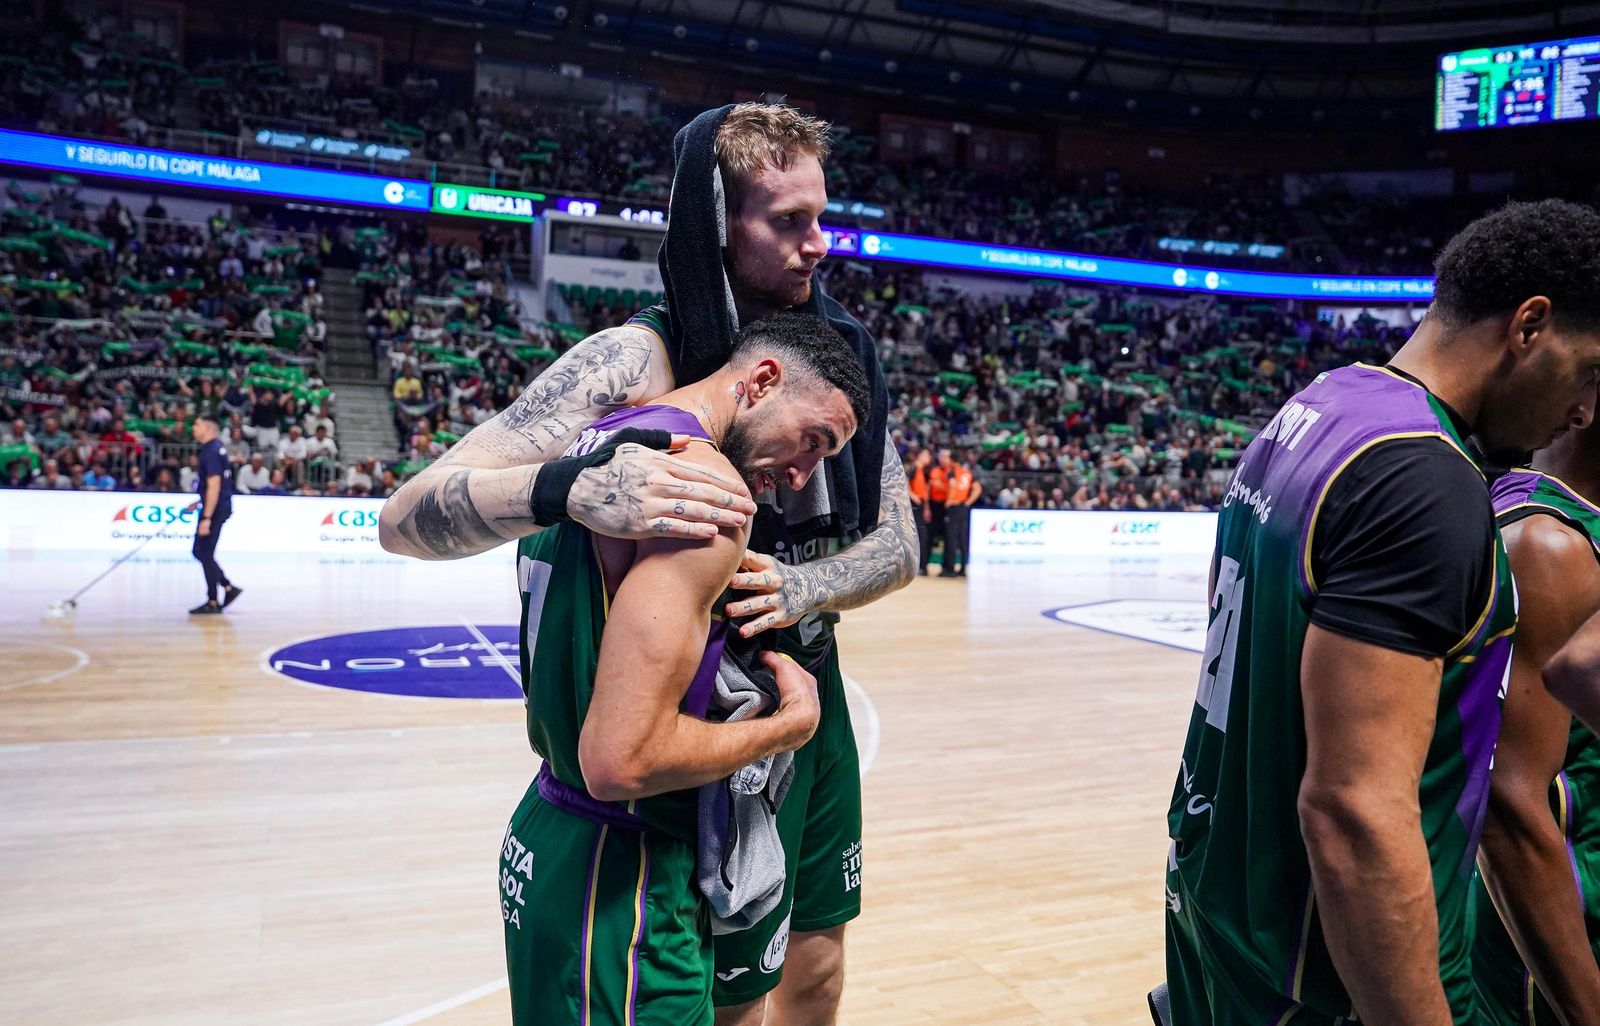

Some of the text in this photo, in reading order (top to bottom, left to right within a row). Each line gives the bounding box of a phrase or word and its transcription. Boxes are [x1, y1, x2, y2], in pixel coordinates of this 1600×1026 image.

[64, 144, 77, 160] Y
[78, 145, 148, 169] SEGUIRLO
[148, 155, 169, 172] EN
[169, 158, 205, 177] COPE
[467, 193, 534, 216] UNICAJA
[338, 508, 379, 527] cas
[1000, 519, 1046, 534] caser
[501, 823, 535, 881] STA
[842, 840, 862, 860] sabo
[843, 870, 862, 893] la
[501, 899, 521, 930] GA
